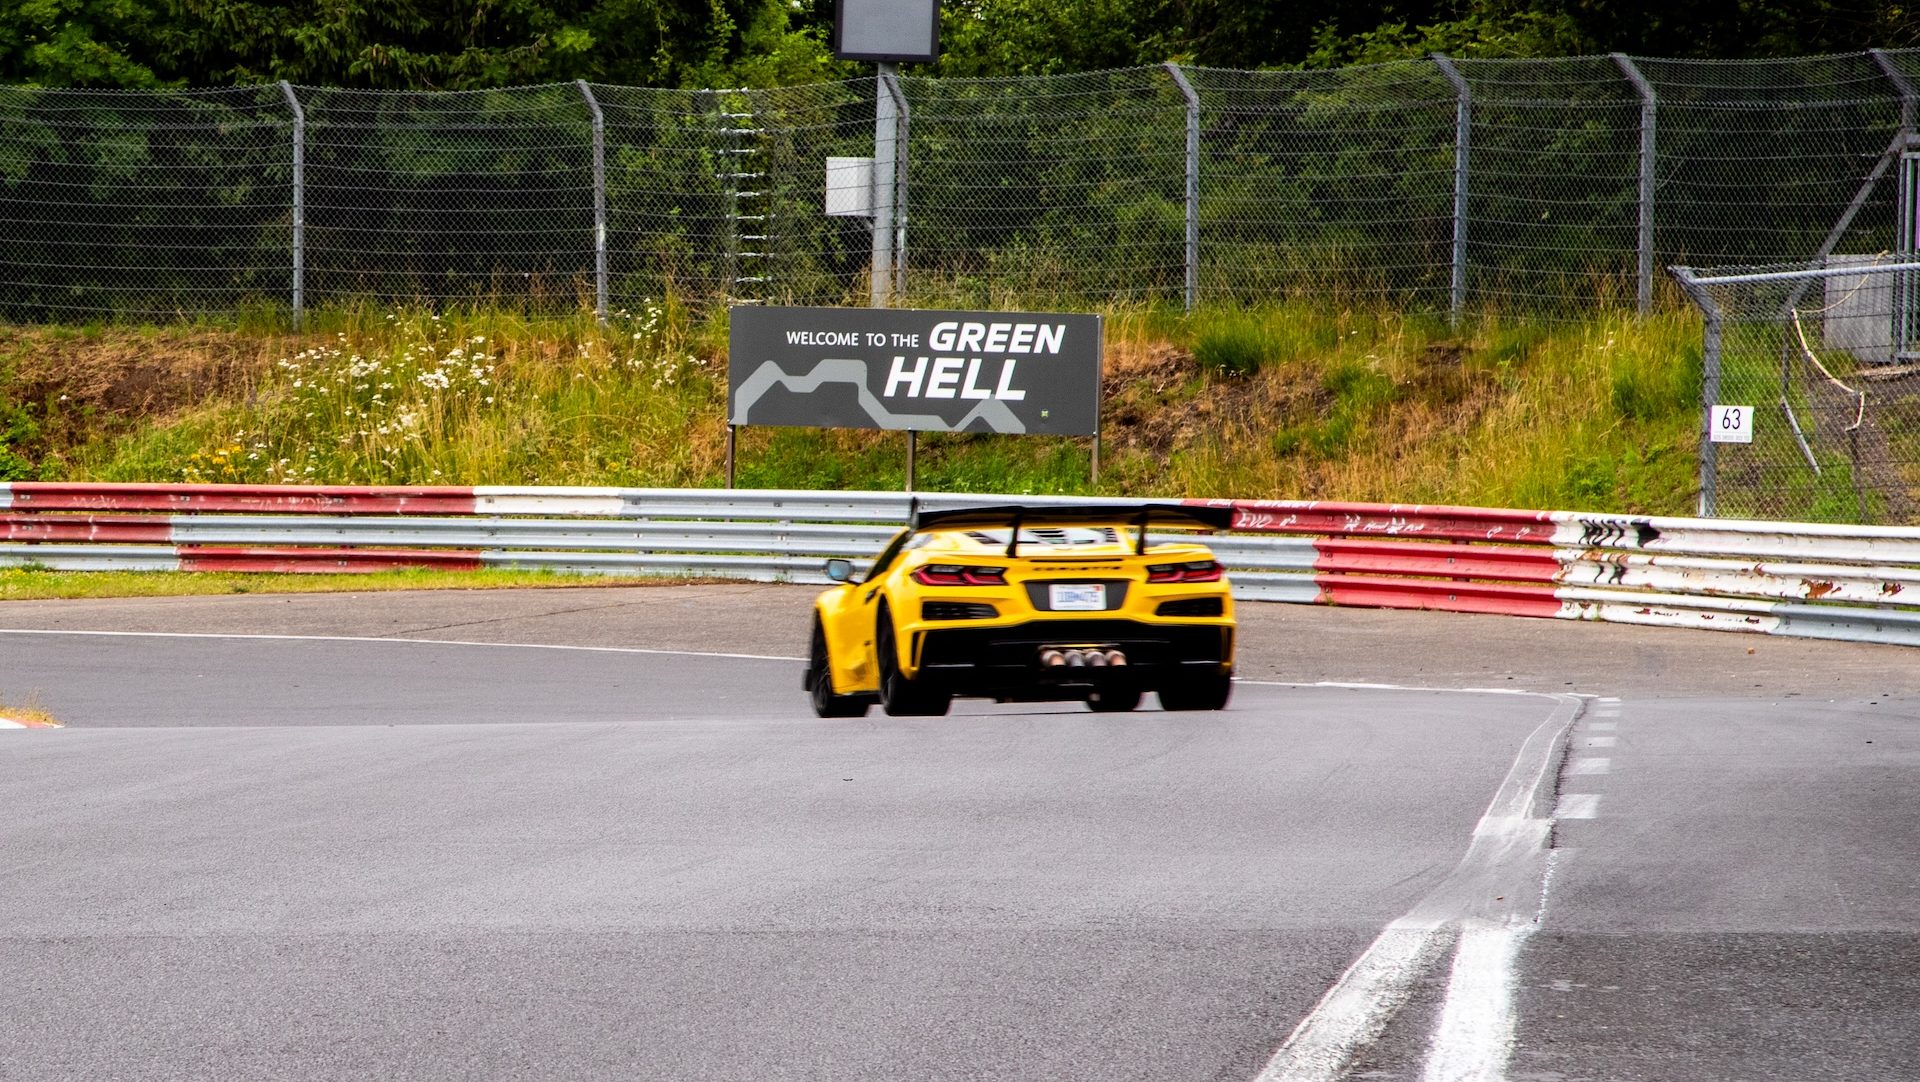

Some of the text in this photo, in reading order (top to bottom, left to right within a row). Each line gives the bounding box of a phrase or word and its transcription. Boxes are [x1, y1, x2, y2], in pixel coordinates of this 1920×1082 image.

[786, 321, 1066, 354] WELCOME TO THE GREEN
[883, 356, 1026, 401] HELL
[1722, 408, 1741, 430] 63
